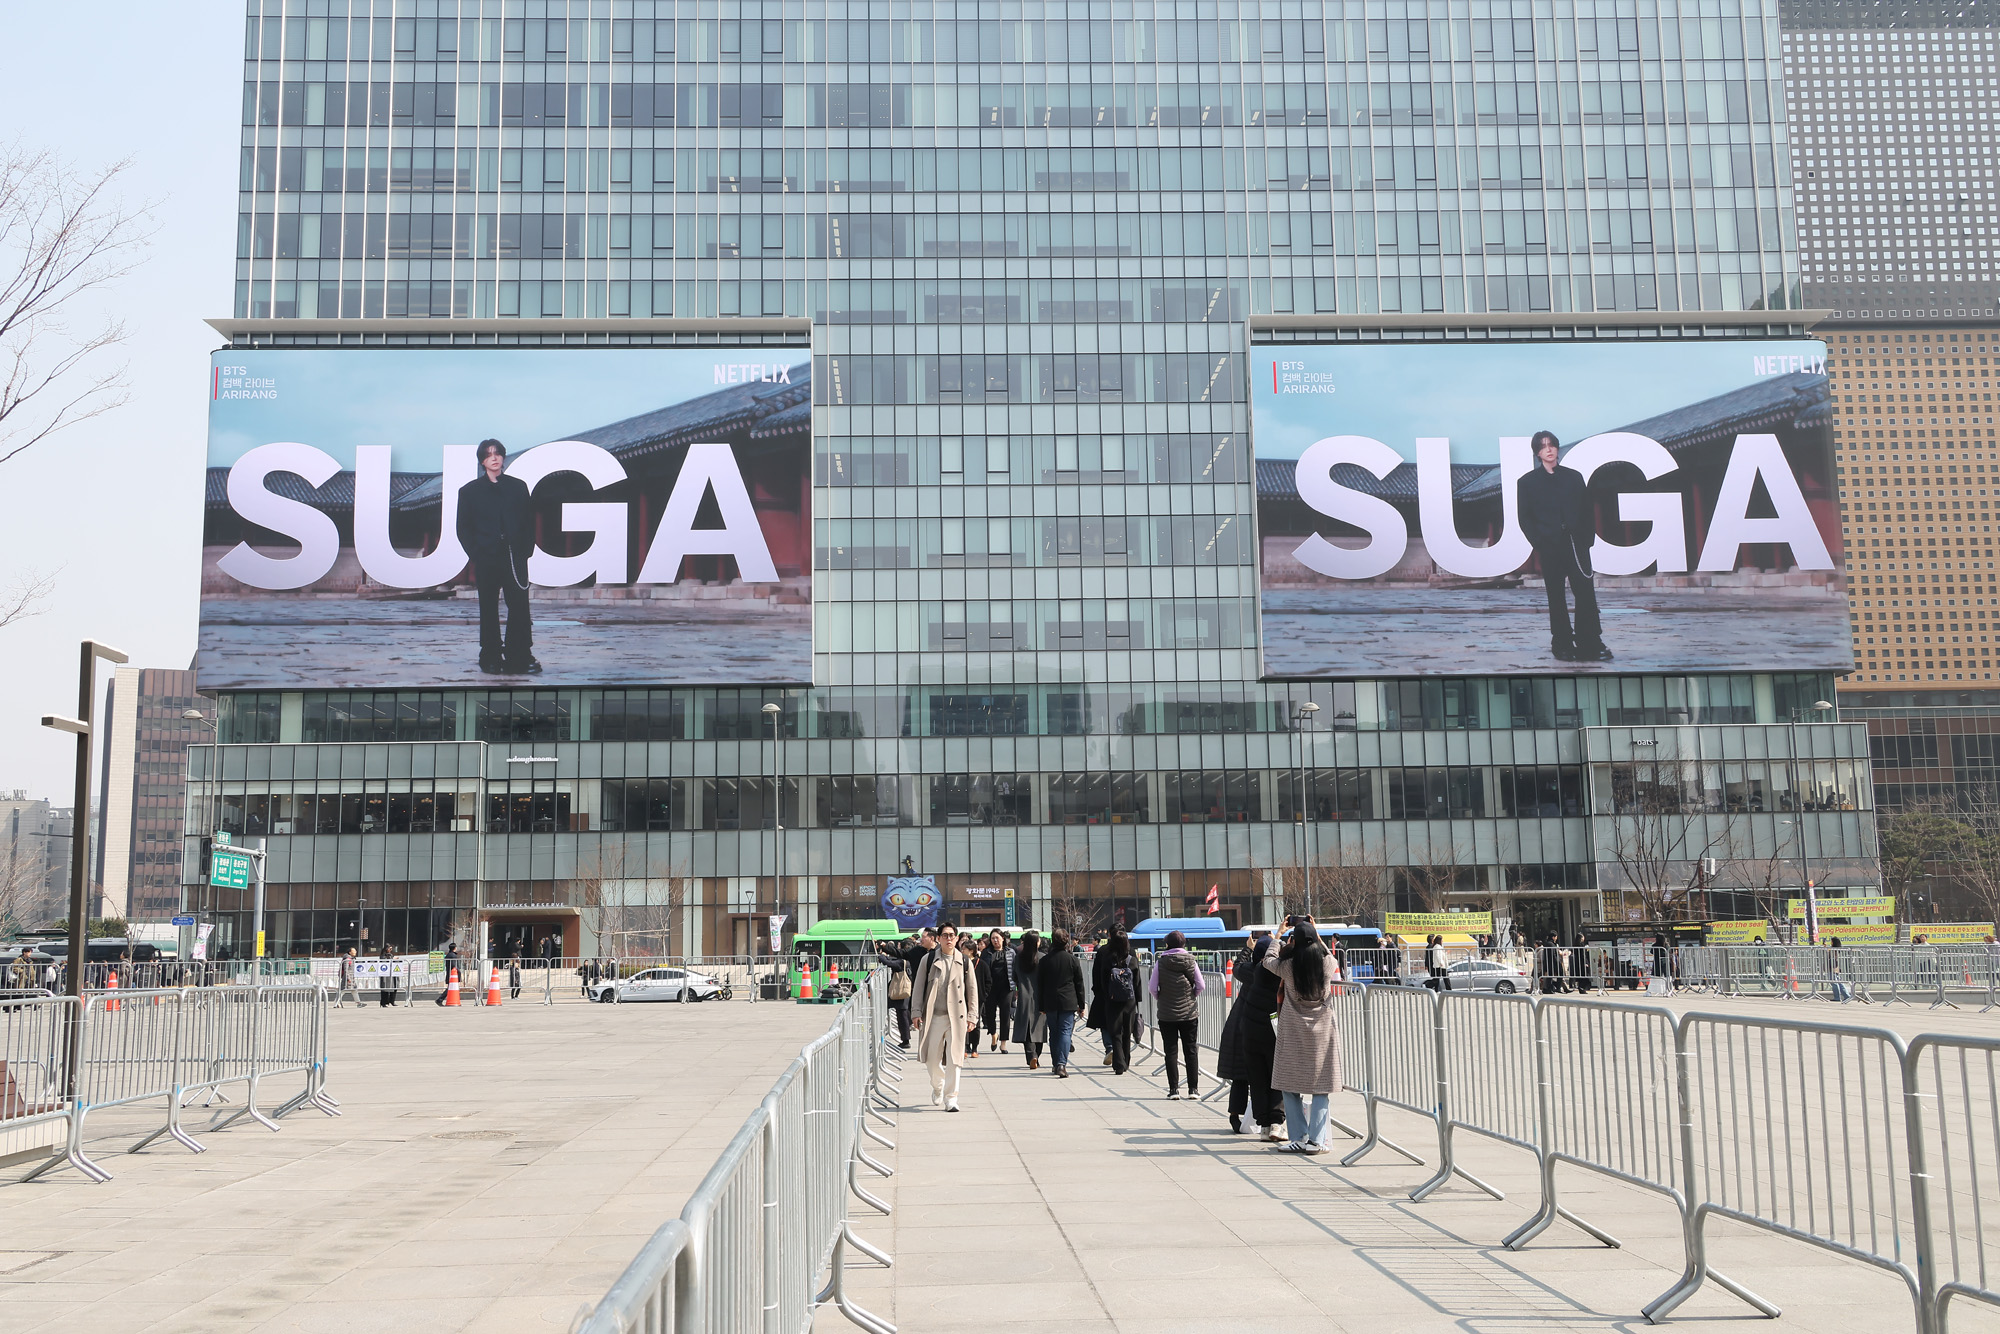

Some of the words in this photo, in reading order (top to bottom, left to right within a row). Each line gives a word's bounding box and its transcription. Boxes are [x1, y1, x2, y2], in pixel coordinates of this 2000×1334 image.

[1282, 361, 1304, 370] BTS
[1753, 355, 1827, 376] NETFLIX
[223, 366, 247, 376] BTS
[714, 364, 791, 385] NETFLIX
[1282, 372, 1301, 383] 컴백
[1304, 372, 1333, 383] 라이브
[223, 378, 242, 389] 컴백
[245, 378, 275, 388] 라이브
[1282, 384, 1336, 394] ARIRANG
[221, 390, 278, 399] ARIRANG
[1292, 432, 1835, 579] SUGA
[216, 440, 781, 590] SUGA
[965, 887, 985, 895] 광화문
[1835, 926, 1868, 934] Palestinian
[1869, 925, 1893, 934] People!
[1864, 934, 1893, 942] Palestine!
